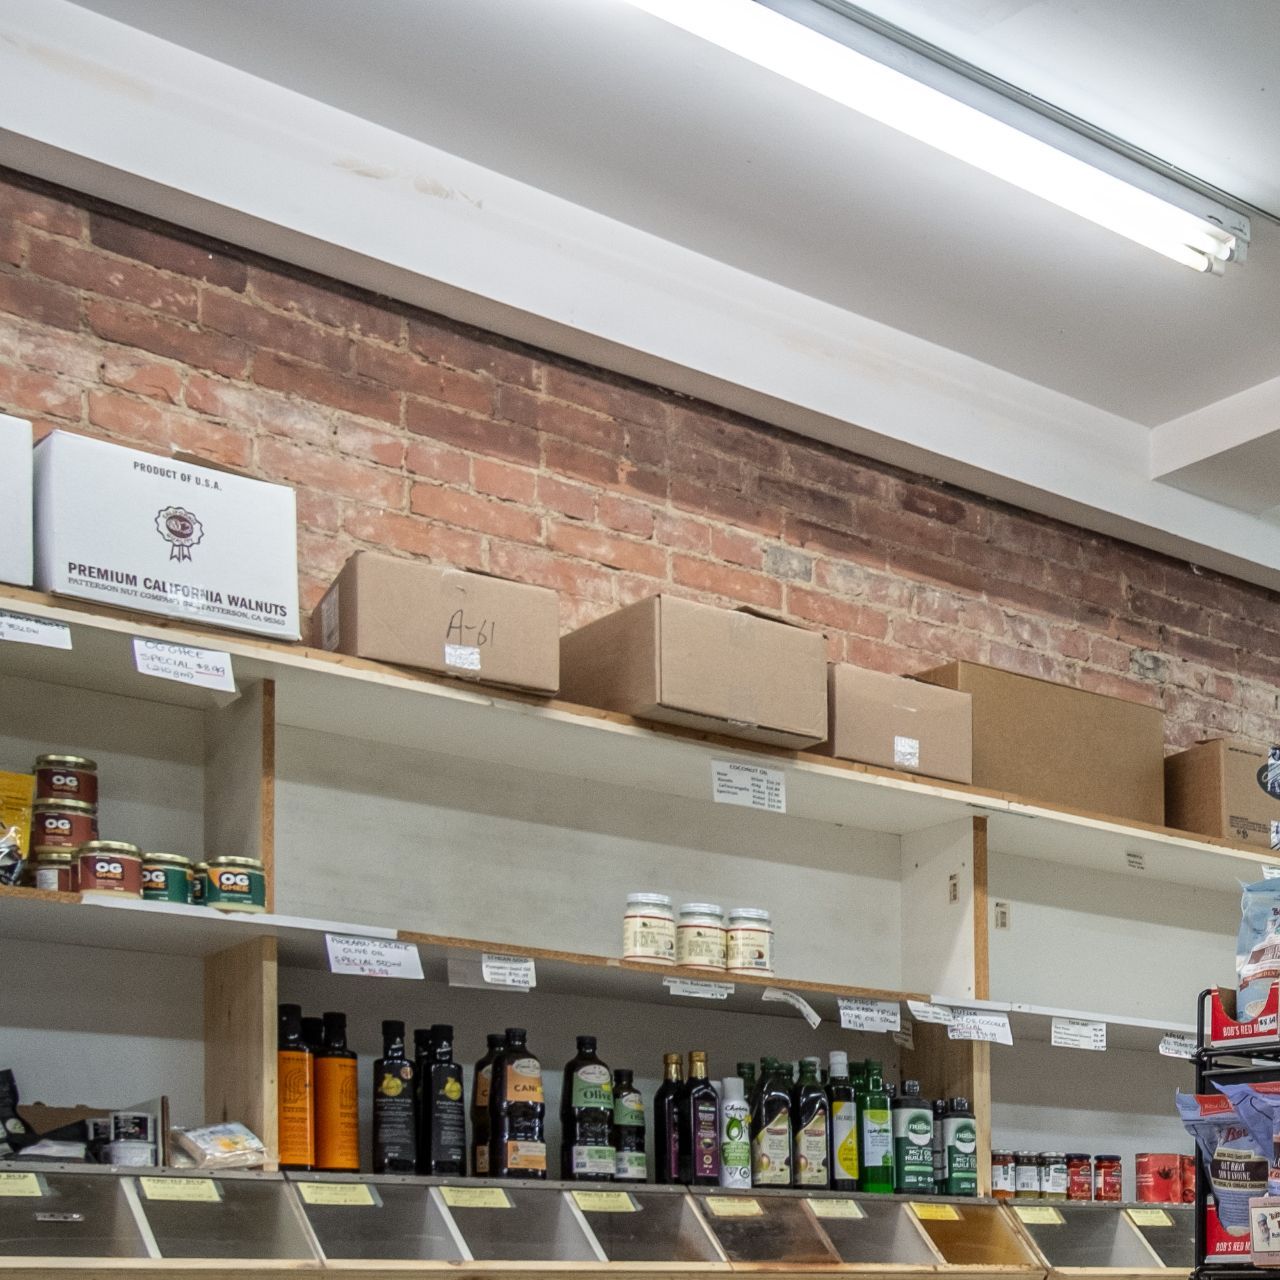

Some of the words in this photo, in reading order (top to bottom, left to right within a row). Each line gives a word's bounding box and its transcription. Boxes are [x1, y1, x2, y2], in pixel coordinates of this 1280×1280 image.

[133, 461, 177, 479] PRODUCT
[180, 472, 192, 483] OF
[195, 477, 222, 491] U.S.A.
[68, 562, 137, 587] PREMIUM
[143, 577, 222, 605] CALIFORNIA
[227, 594, 287, 617] WALNUTS
[68, 577, 119, 594] PATTERSON
[120, 587, 138, 598] NUT
[251, 614, 262, 622] CA
[52, 775, 78, 786] OG
[45, 819, 71, 830] OG
[95, 862, 122, 874] OG
[220, 873, 250, 886] OG
[583, 1087, 613, 1101] Olive
